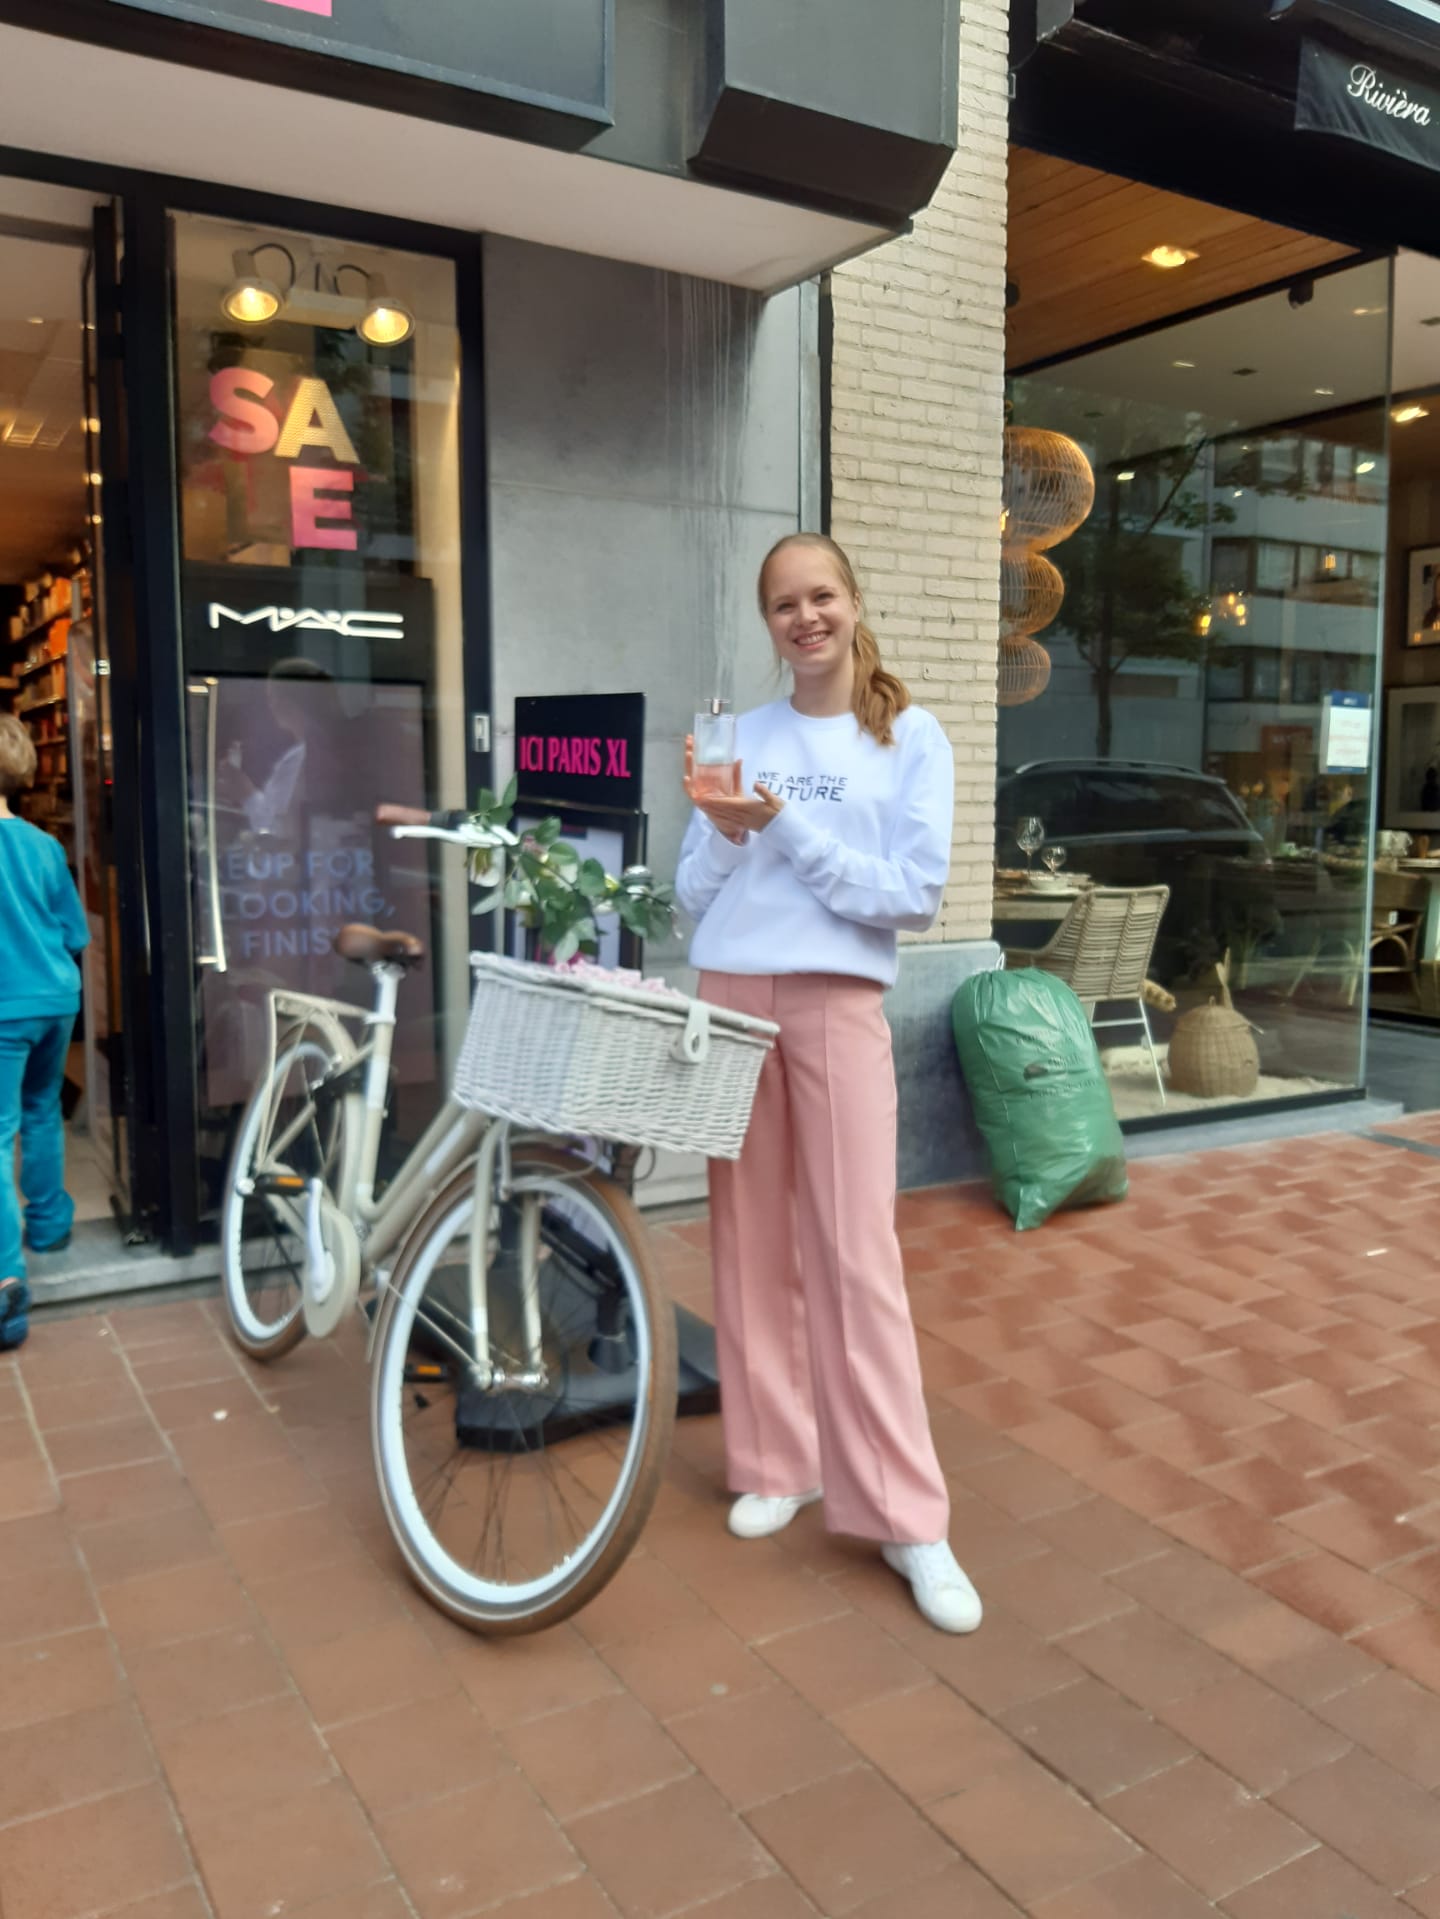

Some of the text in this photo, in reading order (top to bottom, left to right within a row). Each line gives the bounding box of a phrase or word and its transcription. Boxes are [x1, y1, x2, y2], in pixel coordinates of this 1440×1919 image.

[1346, 64, 1430, 126] Rivièra
[519, 736, 632, 778] ICI PARIS XL
[757, 771, 848, 786] WE ARE THE
[244, 929, 341, 958] FINIS
